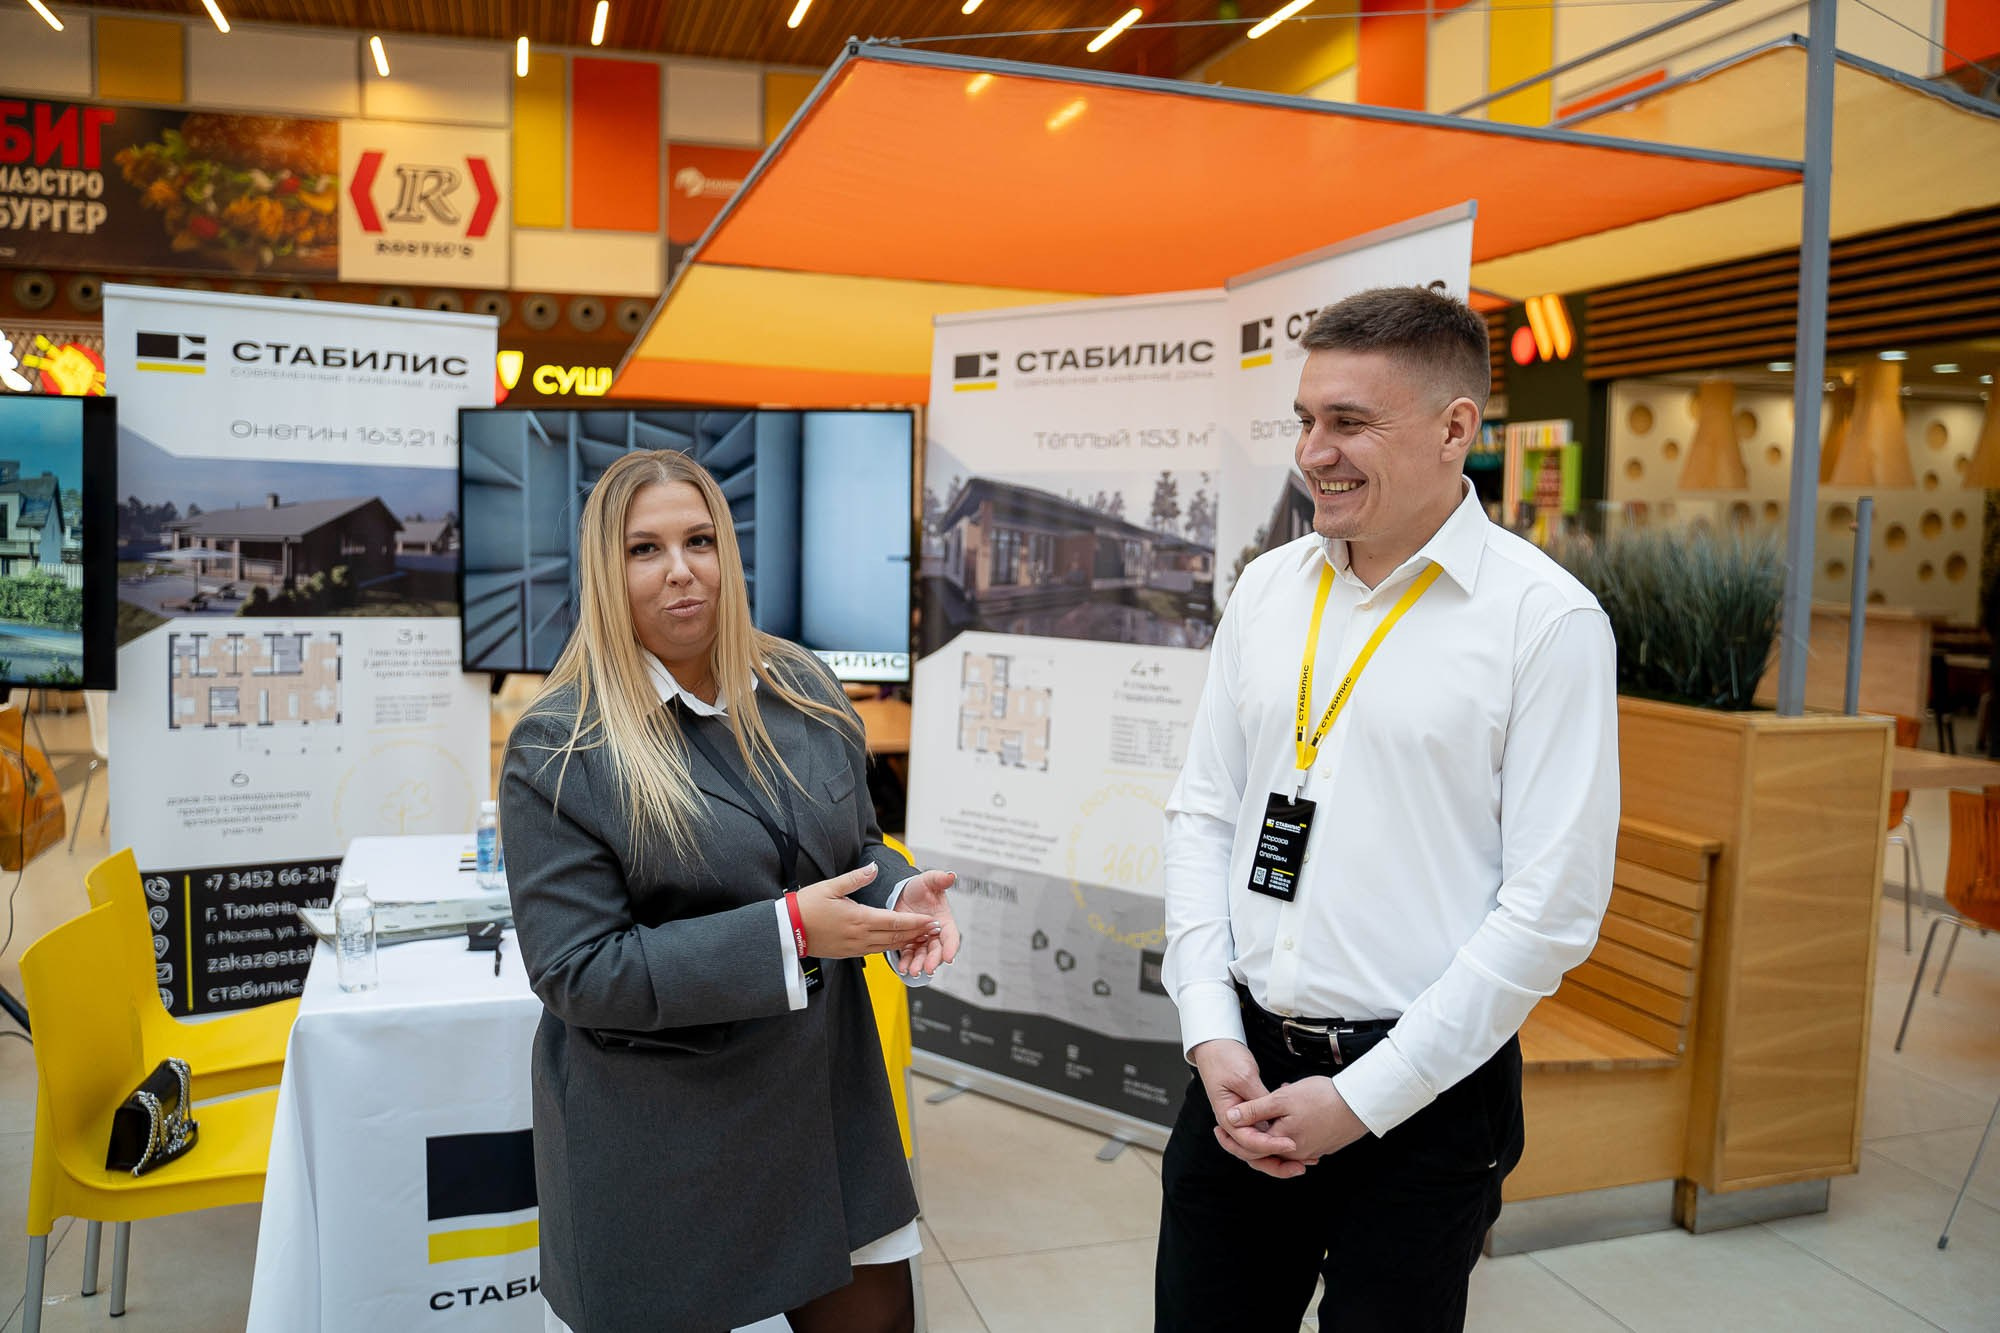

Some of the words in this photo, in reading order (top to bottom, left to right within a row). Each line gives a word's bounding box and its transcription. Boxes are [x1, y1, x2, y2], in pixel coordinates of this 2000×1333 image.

[0, 101, 116, 168] БИГ
[232, 340, 469, 376] СТАБИЛИС
[1016, 341, 1215, 373] СТАБИЛИС
[356, 426, 436, 449] 163,21
[1138, 428, 1181, 448] 153
[1298, 664, 1310, 721] СТАБИЛИС
[1321, 676, 1352, 729] СТАБИЛИС
[228, 870, 274, 890] 3452
[207, 978, 306, 1003] стабилис.
